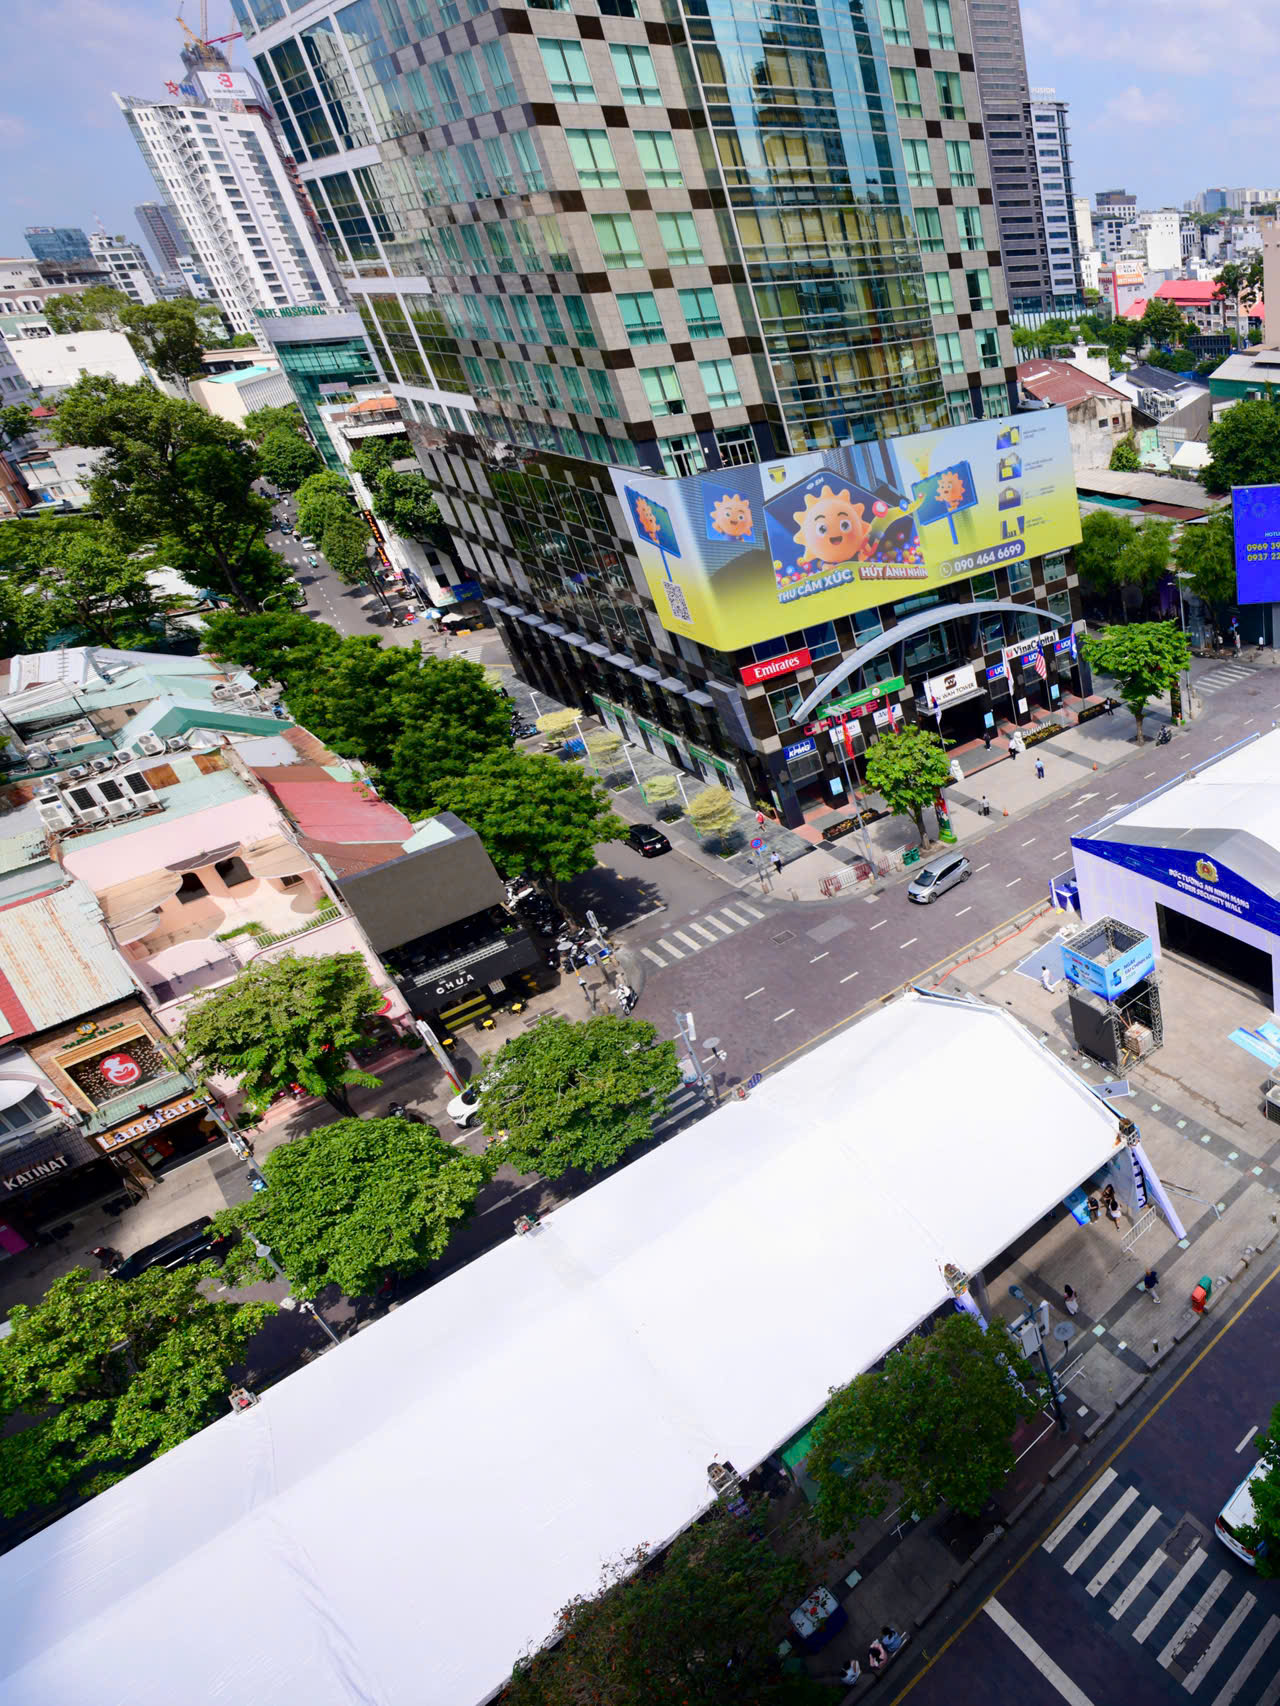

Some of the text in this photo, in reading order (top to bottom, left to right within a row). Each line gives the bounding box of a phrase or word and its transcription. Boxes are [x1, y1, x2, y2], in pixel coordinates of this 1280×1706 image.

[954, 543, 1022, 573] 090 464 6699
[1271, 542, 1280, 550] 39
[1271, 552, 1280, 560] 22
[778, 589, 797, 603] THU
[824, 569, 853, 587] XÚC
[754, 657, 800, 679] Emirates
[803, 700, 879, 737] CHUBB
[788, 744, 811, 758] KPMG
[1177, 880, 1243, 914] CYBER SECURITY WALL
[1204, 884, 1214, 893] AN
[1213, 887, 1230, 900] NINH
[95, 1095, 212, 1150] Langfarm
[3, 1155, 68, 1191] KATINAT
